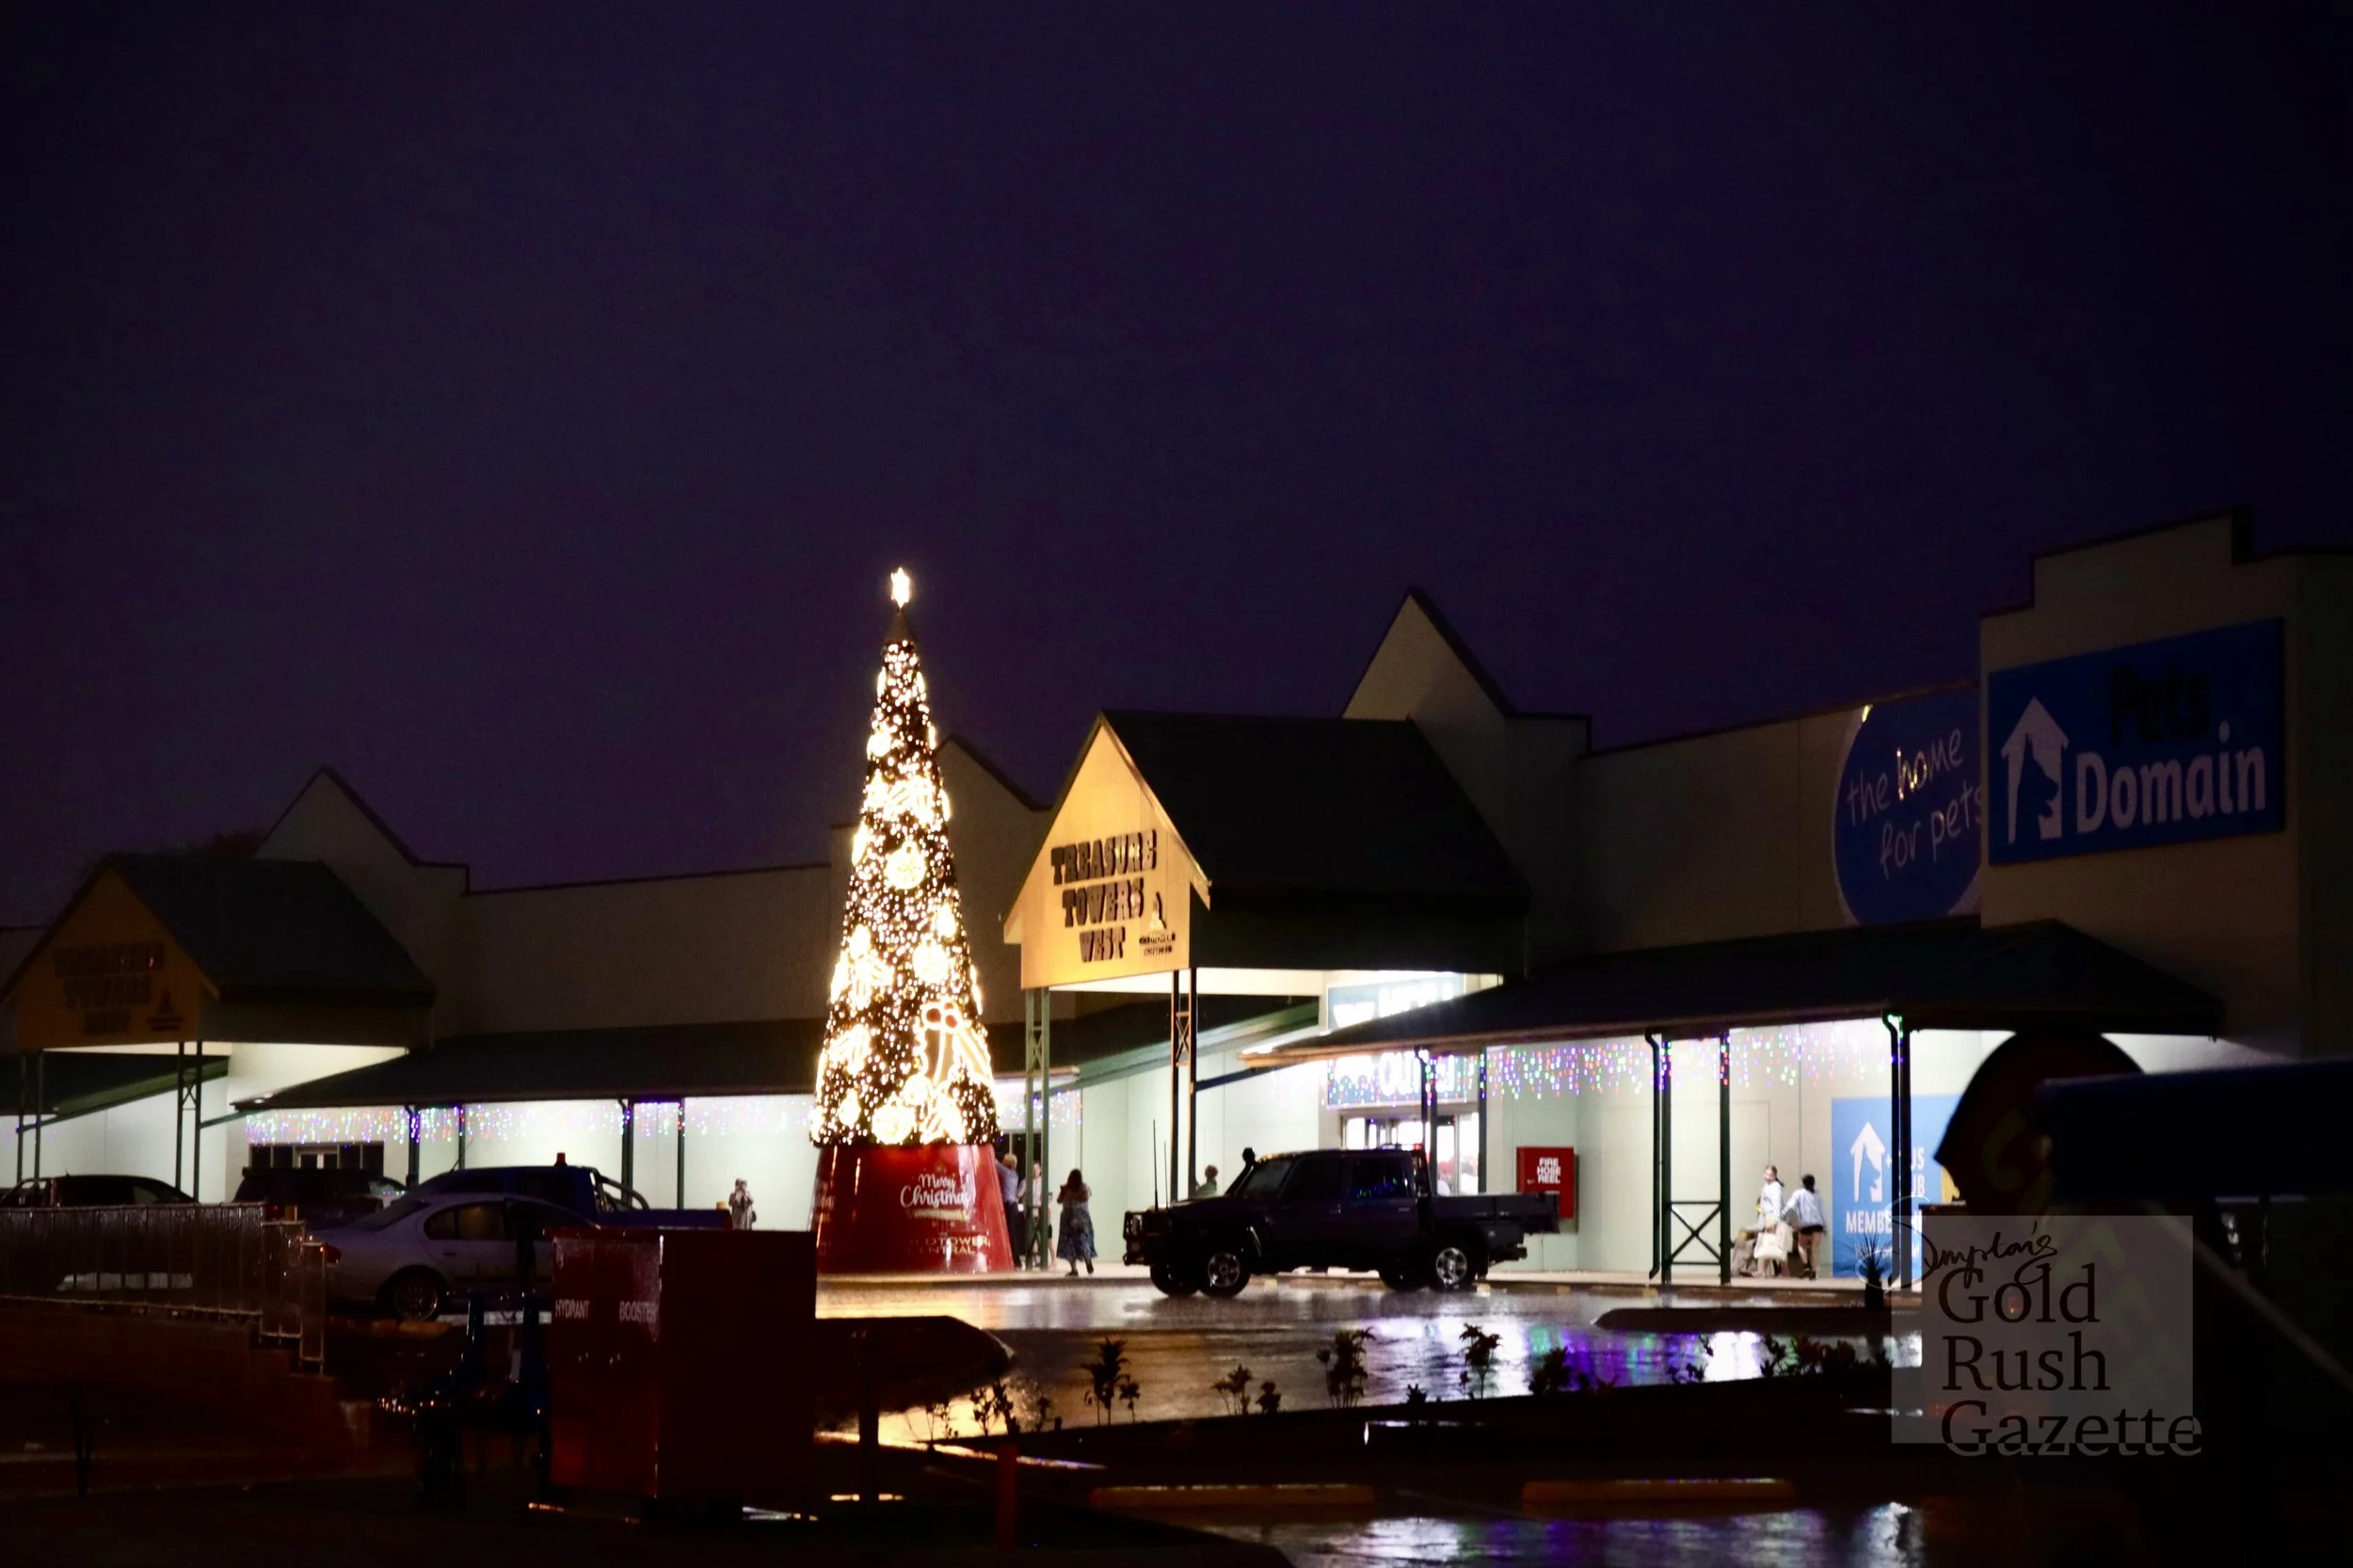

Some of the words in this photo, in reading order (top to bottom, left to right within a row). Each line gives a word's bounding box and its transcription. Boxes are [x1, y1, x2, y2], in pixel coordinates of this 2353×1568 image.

[2110, 666, 2210, 742] Pets
[1847, 772, 1890, 828] the
[1896, 728, 1963, 802] home
[2075, 720, 2267, 835] Domain
[1050, 829, 1157, 886] TREASURE
[1879, 821, 1923, 881] for
[1062, 877, 1144, 928] TOWERS
[1079, 926, 1126, 963] WEST
[918, 1173, 957, 1193] Merry
[1537, 1166, 1561, 1176] HOSE
[1538, 1175, 1561, 1185] REEL
[1539, 1157, 1560, 1167] FIRE
[554, 1298, 590, 1320] HYDRANT
[618, 1299, 658, 1324] BOOSTER
